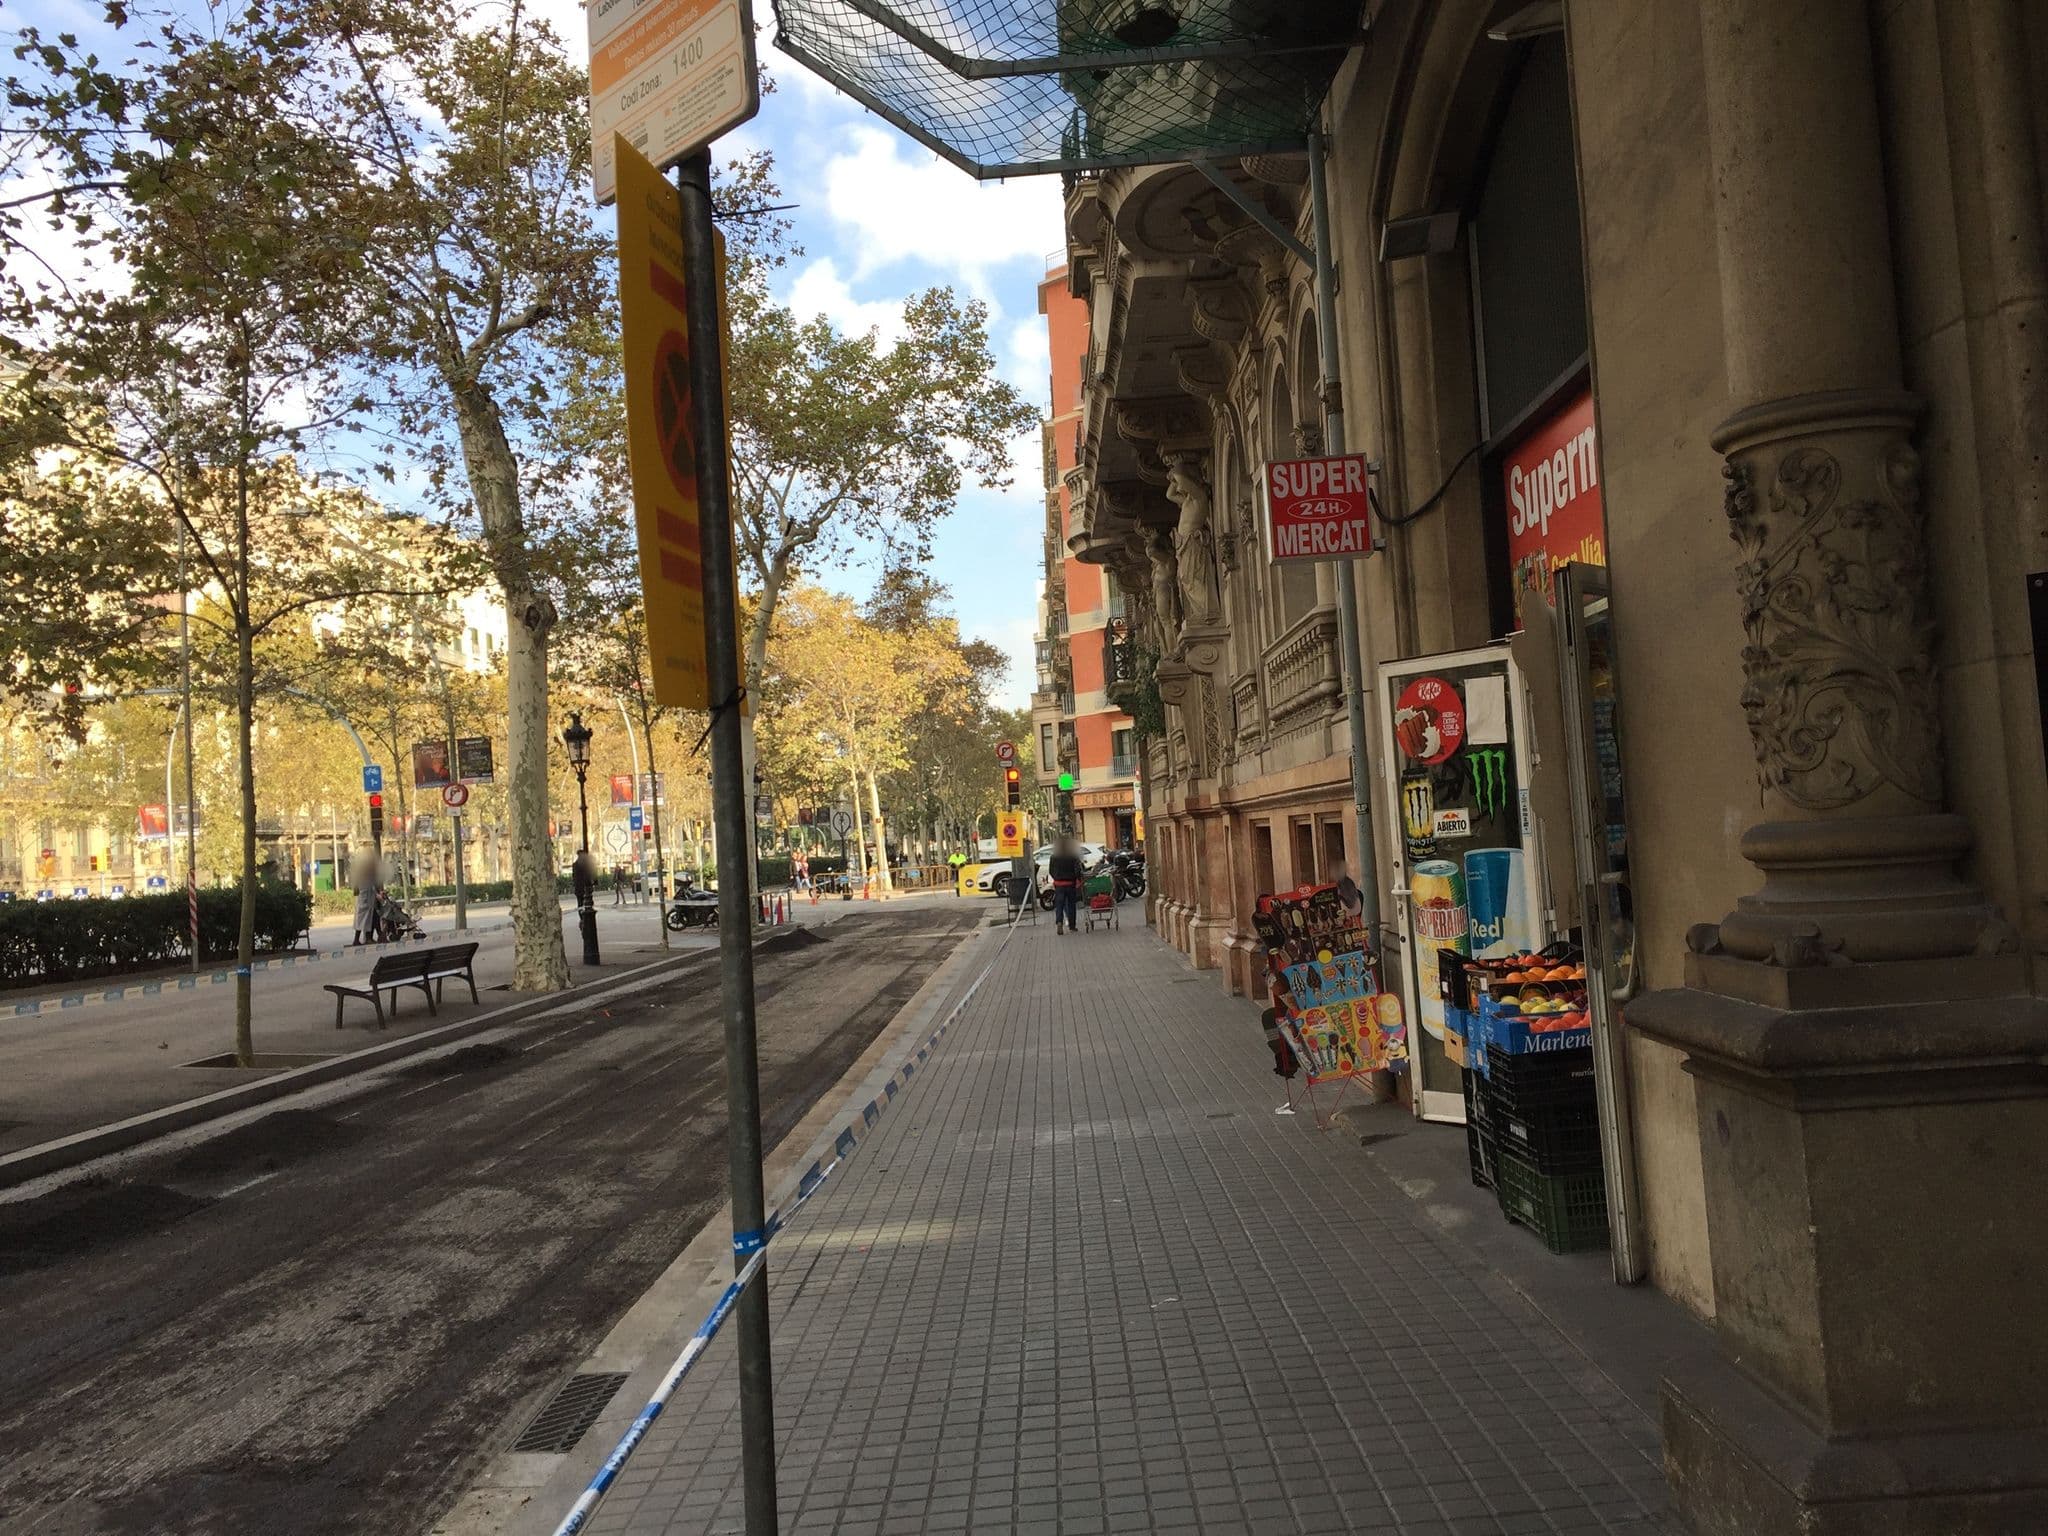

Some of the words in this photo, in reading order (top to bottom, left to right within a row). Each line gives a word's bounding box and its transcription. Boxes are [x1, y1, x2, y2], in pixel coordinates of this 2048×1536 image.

[621, 86, 638, 111] Codi
[640, 73, 662, 98] Zona:
[673, 36, 703, 76] 1400
[1272, 460, 1364, 499] SUPER
[1277, 519, 1366, 557] MERCAT
[1436, 820, 1467, 833] ABIERTO
[1471, 916, 1500, 938] Red
